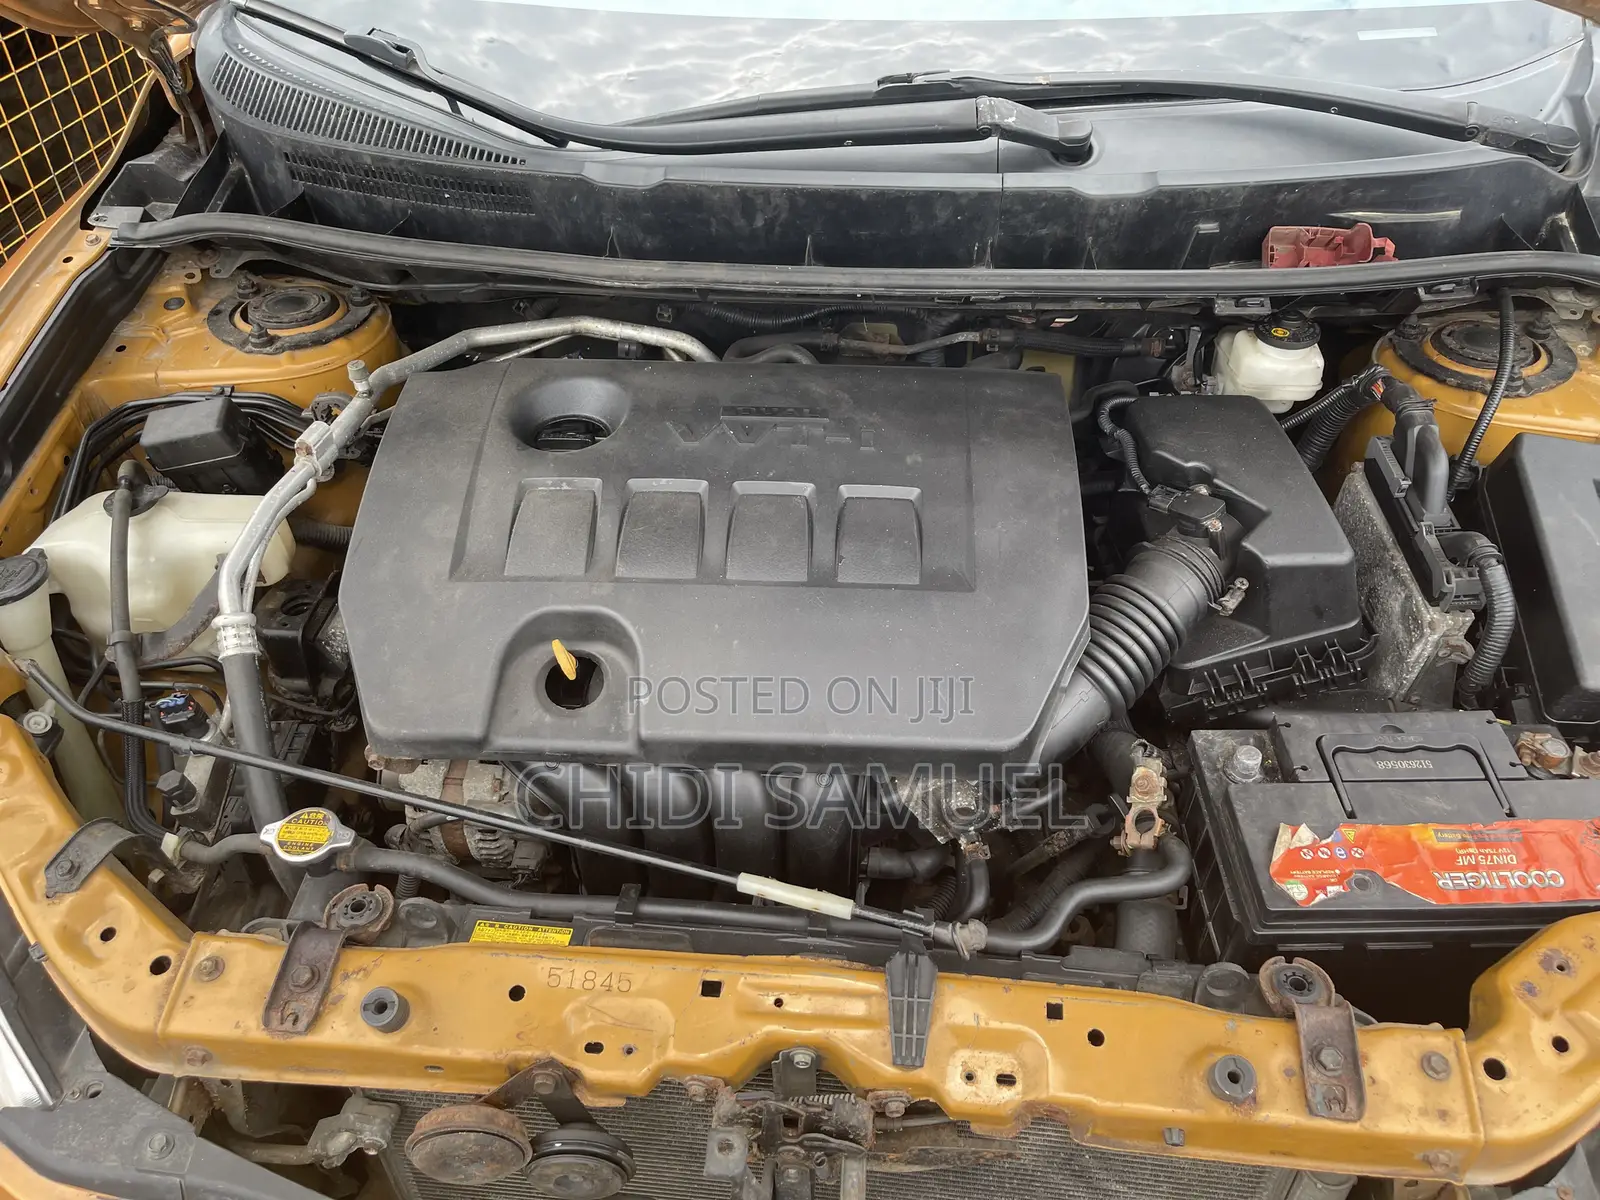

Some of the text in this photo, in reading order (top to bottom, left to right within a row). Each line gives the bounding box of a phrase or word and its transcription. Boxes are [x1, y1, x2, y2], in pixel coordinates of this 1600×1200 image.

[1376, 760, 1433, 769] 512630568
[1455, 854, 1517, 866] DIN75 MF
[1432, 869, 1565, 890] COOLTIGER
[547, 967, 634, 992] 51845
